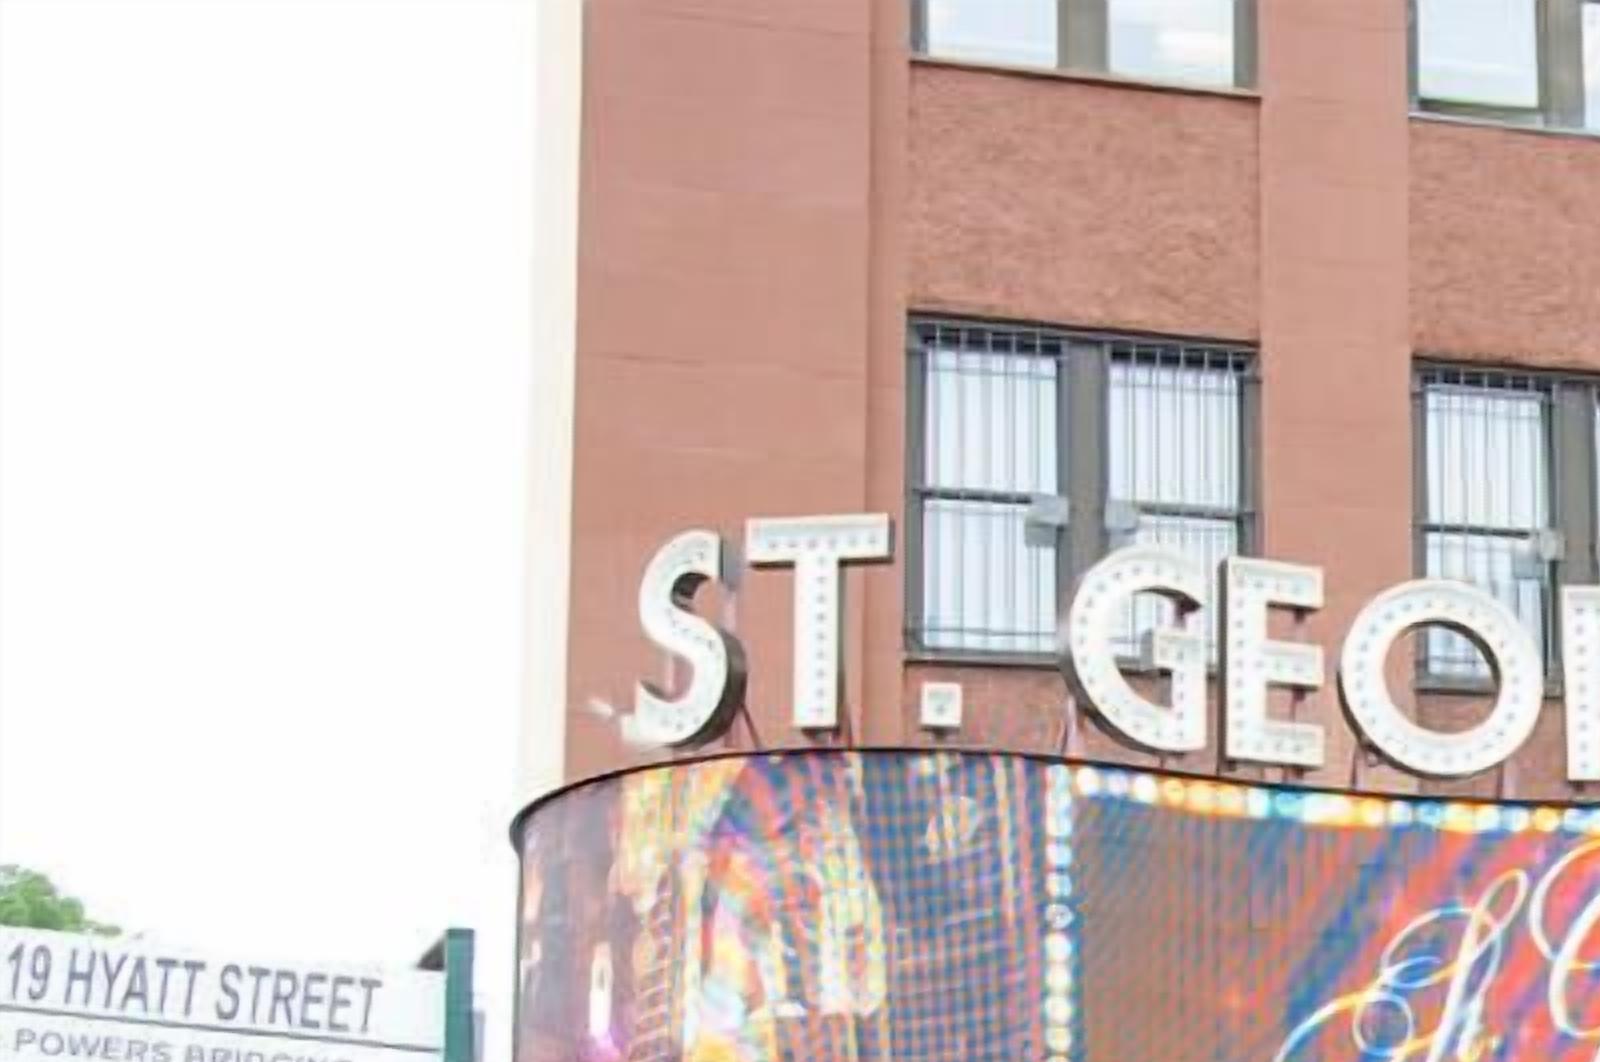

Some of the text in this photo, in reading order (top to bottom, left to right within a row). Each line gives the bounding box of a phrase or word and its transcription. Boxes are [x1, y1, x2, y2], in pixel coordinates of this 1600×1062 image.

[622, 512, 963, 748] ST.
[7, 942, 383, 1034] 19 HYATT STREET
